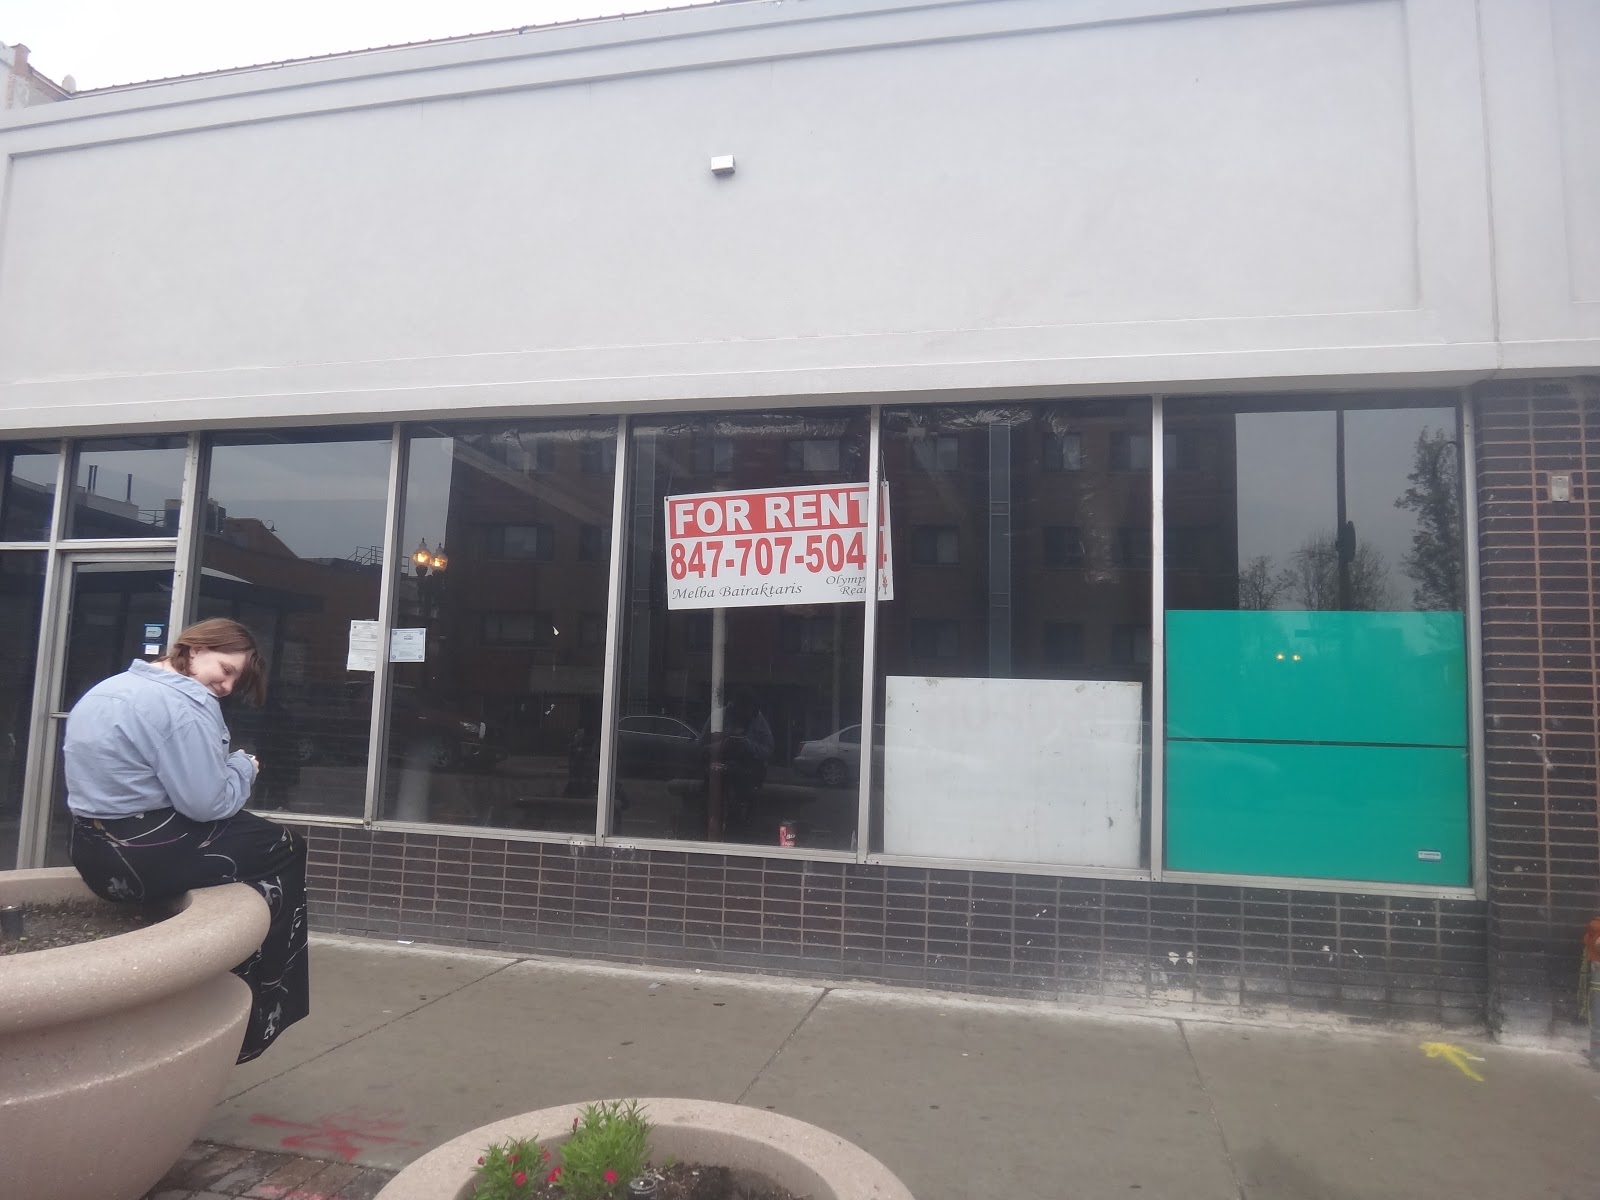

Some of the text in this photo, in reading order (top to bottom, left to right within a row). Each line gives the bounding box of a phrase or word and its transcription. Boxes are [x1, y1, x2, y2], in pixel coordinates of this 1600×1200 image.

[675, 492, 868, 535] FOR RENT
[825, 574, 866, 587] Olymp
[672, 582, 803, 600] Melba Bairaktaris
[840, 585, 880, 596] Real
